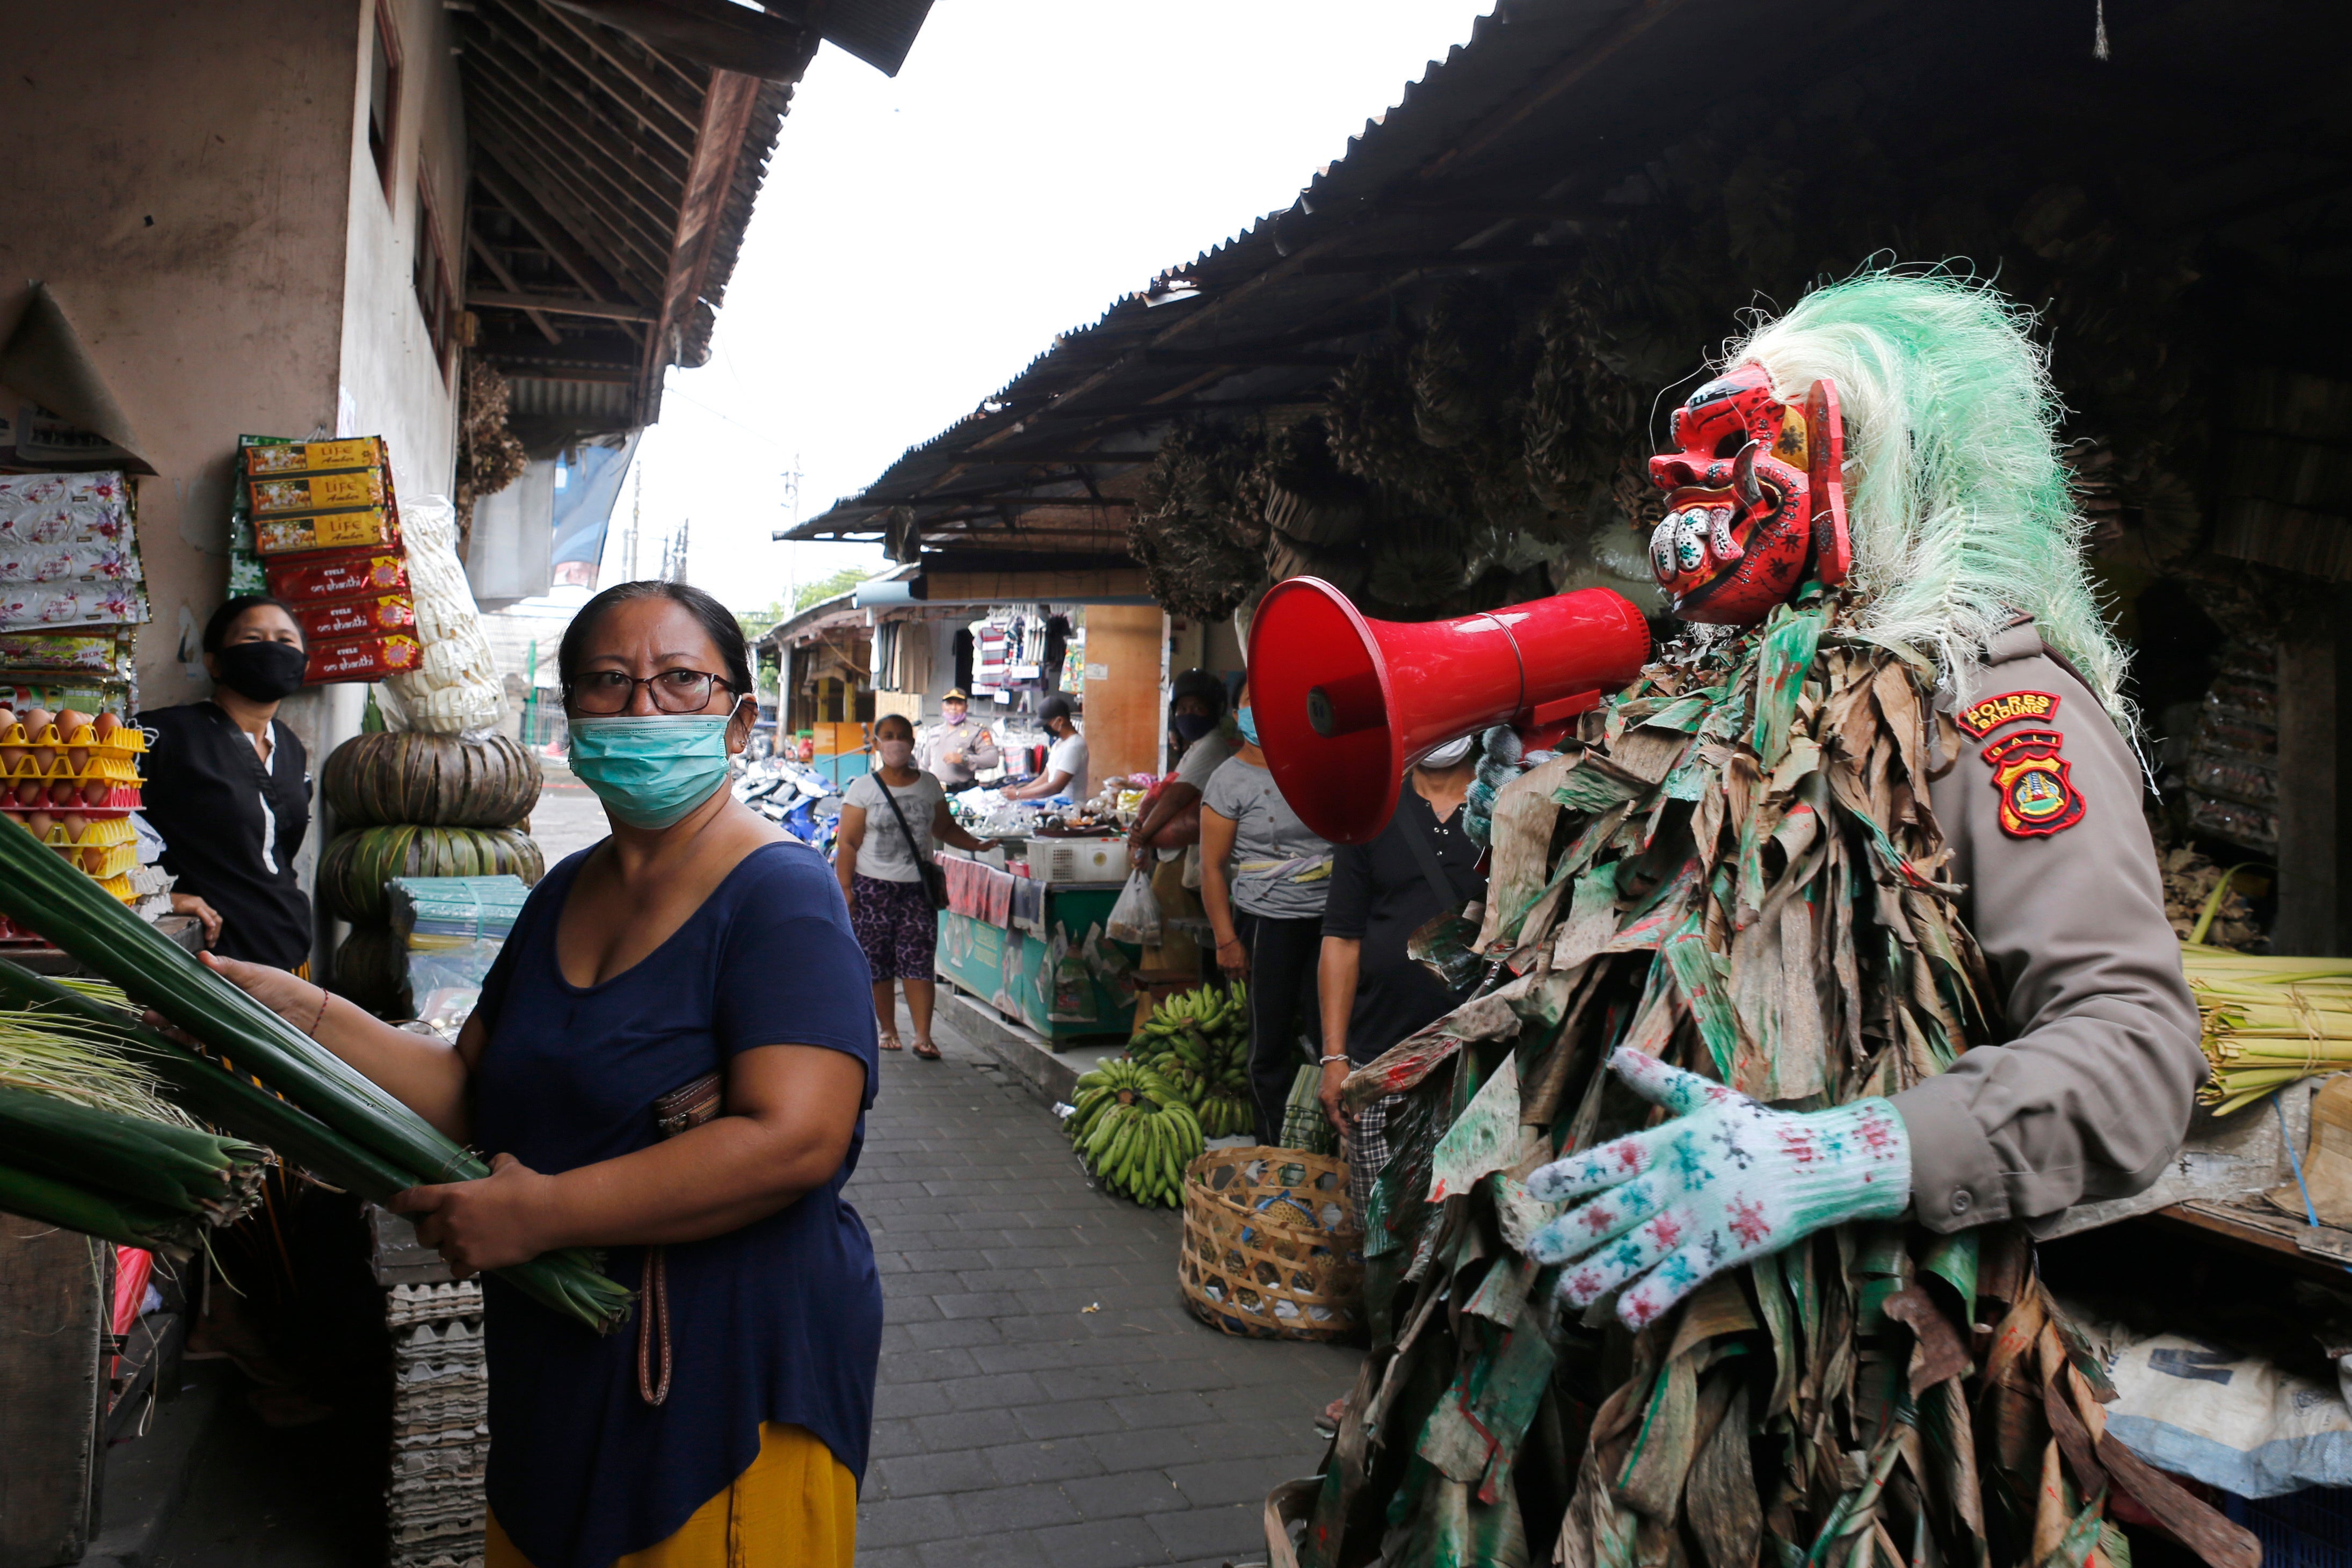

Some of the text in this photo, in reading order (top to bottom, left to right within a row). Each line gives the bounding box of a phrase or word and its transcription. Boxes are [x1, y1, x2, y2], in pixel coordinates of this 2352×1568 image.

[326, 493, 359, 502] Amber
[331, 532, 364, 541] Amber
[326, 576, 361, 591] shanthi
[333, 615, 367, 631] shanthi
[339, 655, 374, 671] shanthi
[1968, 694, 2050, 725] POLRES
[1978, 705, 2045, 729] BADUNG
[1991, 735, 2057, 756] BALI
